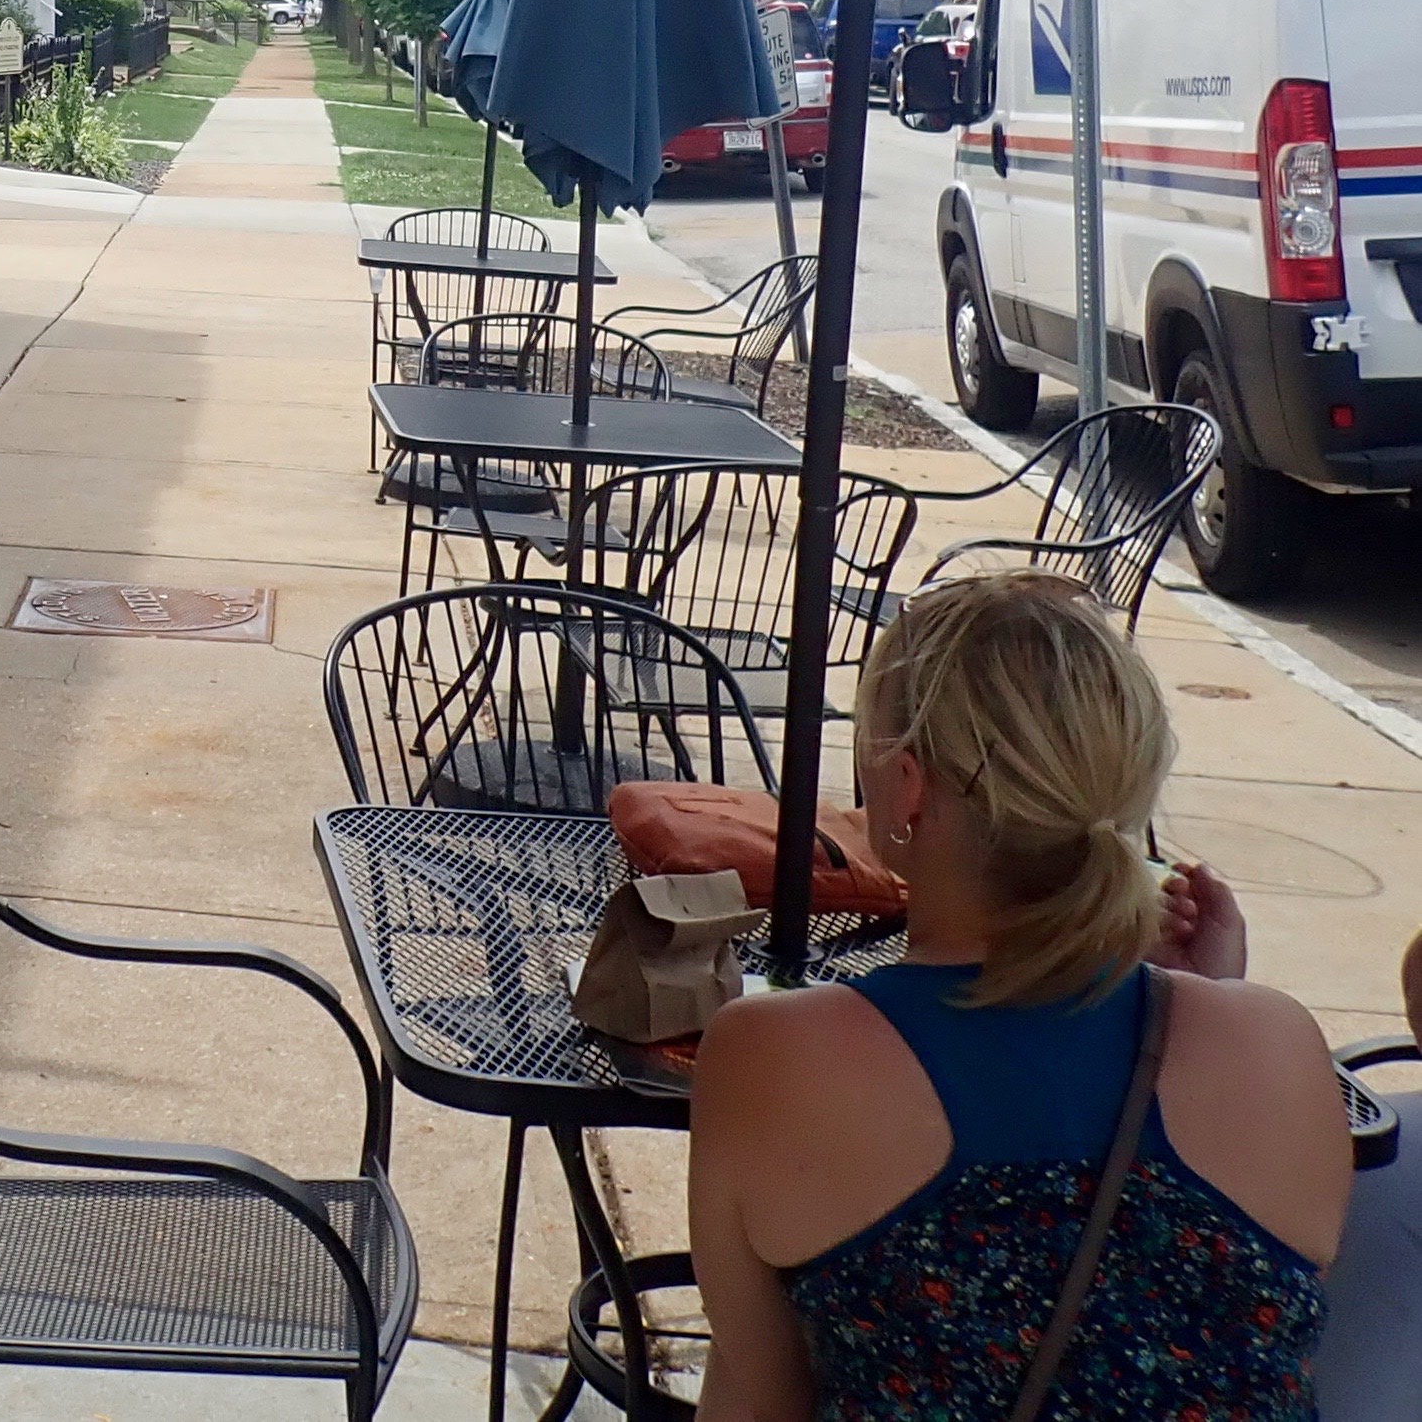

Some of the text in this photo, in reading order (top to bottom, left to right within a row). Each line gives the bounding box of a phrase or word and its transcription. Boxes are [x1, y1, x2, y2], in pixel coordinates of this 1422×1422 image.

[762, 20, 769, 36] 5
[765, 34, 785, 53] UTE
[770, 50, 790, 69] ING
[1165, 76, 1231, 103] www.usps.com
